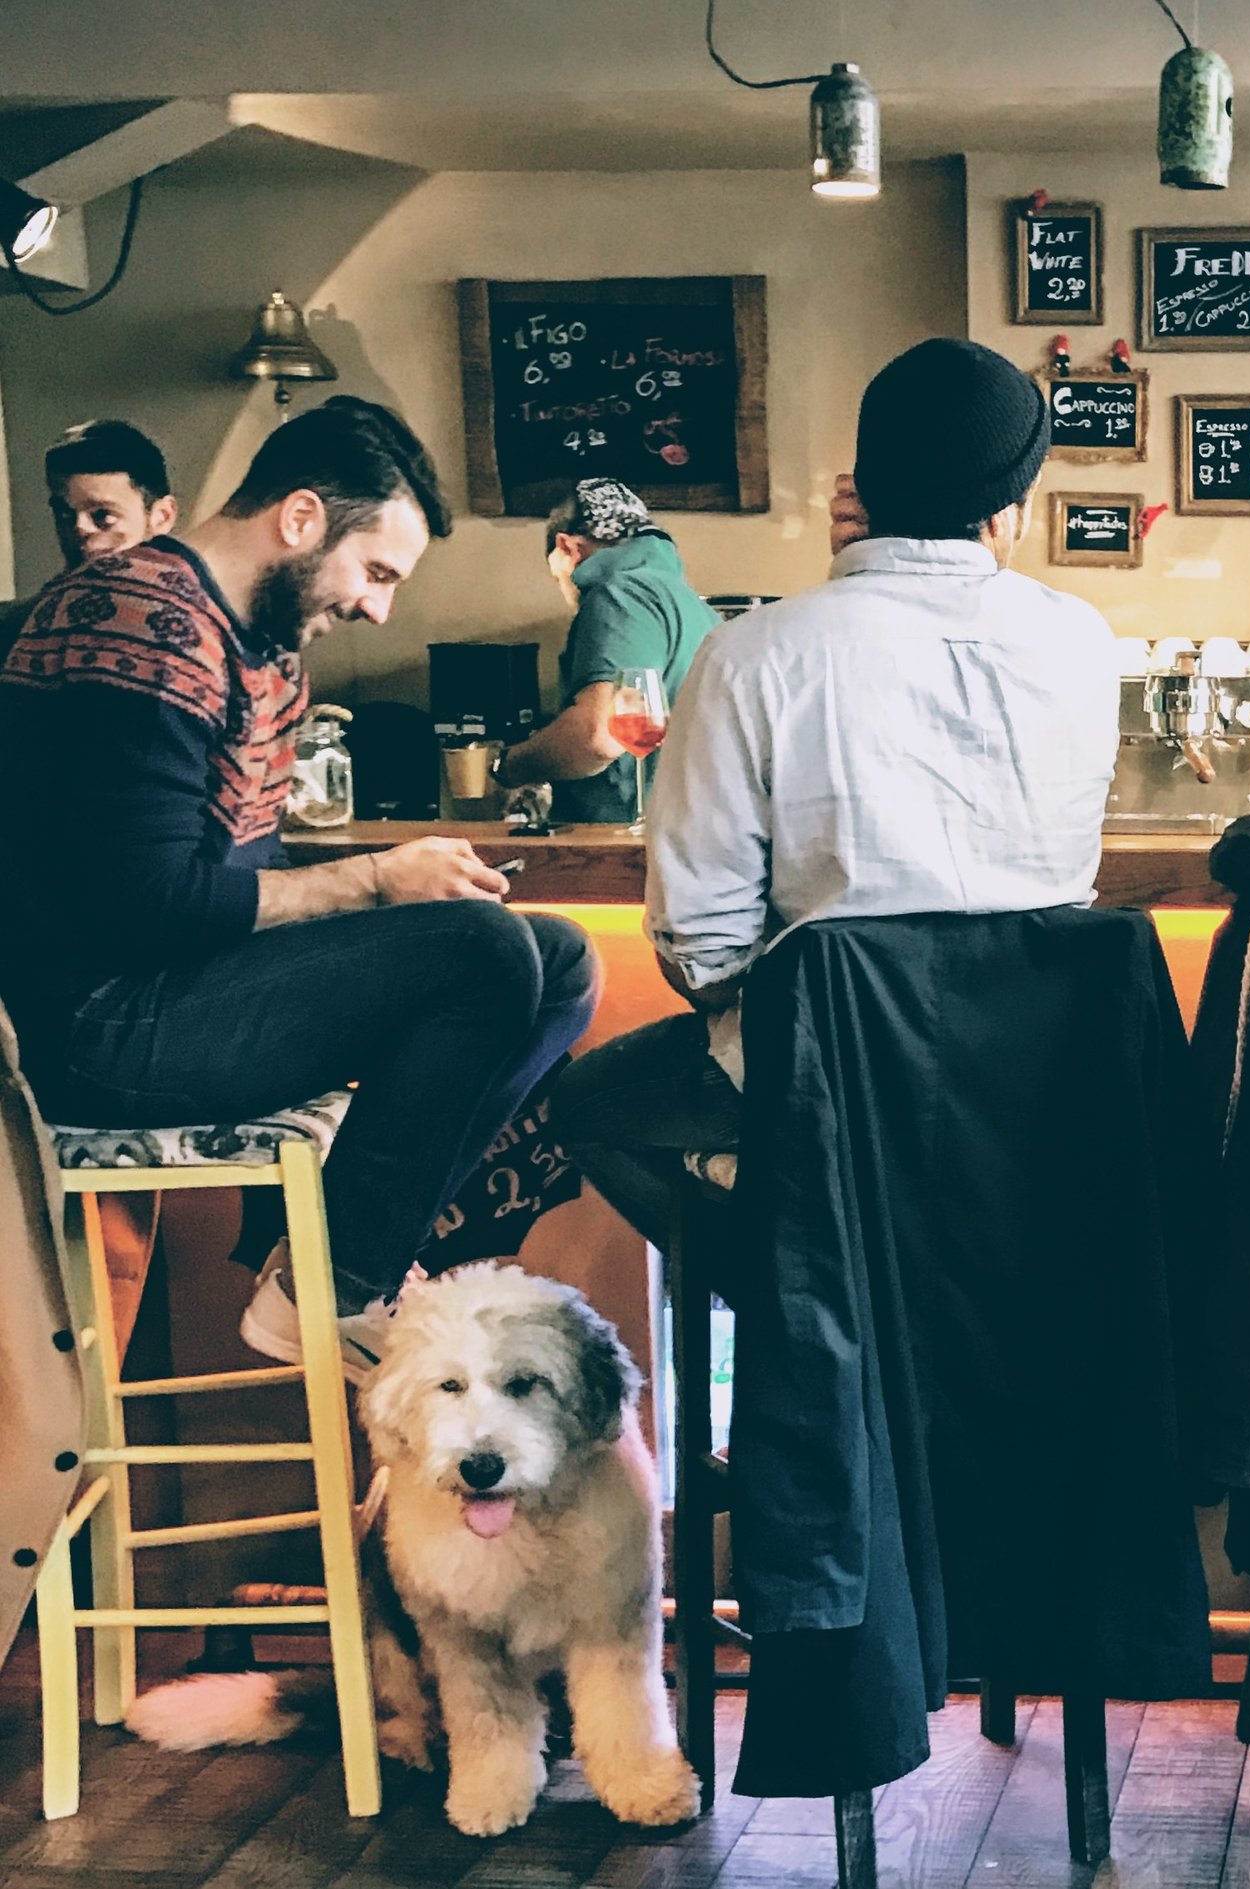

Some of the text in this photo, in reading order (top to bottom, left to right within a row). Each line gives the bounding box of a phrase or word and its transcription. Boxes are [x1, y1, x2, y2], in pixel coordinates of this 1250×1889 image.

[1030, 221, 1082, 247] FLAT
[1028, 250, 1083, 271] WHITE
[528, 313, 588, 345] FIGO
[1053, 386, 1135, 415] CAPPUCCINO
[1195, 418, 1249, 433] ESPRESSO
